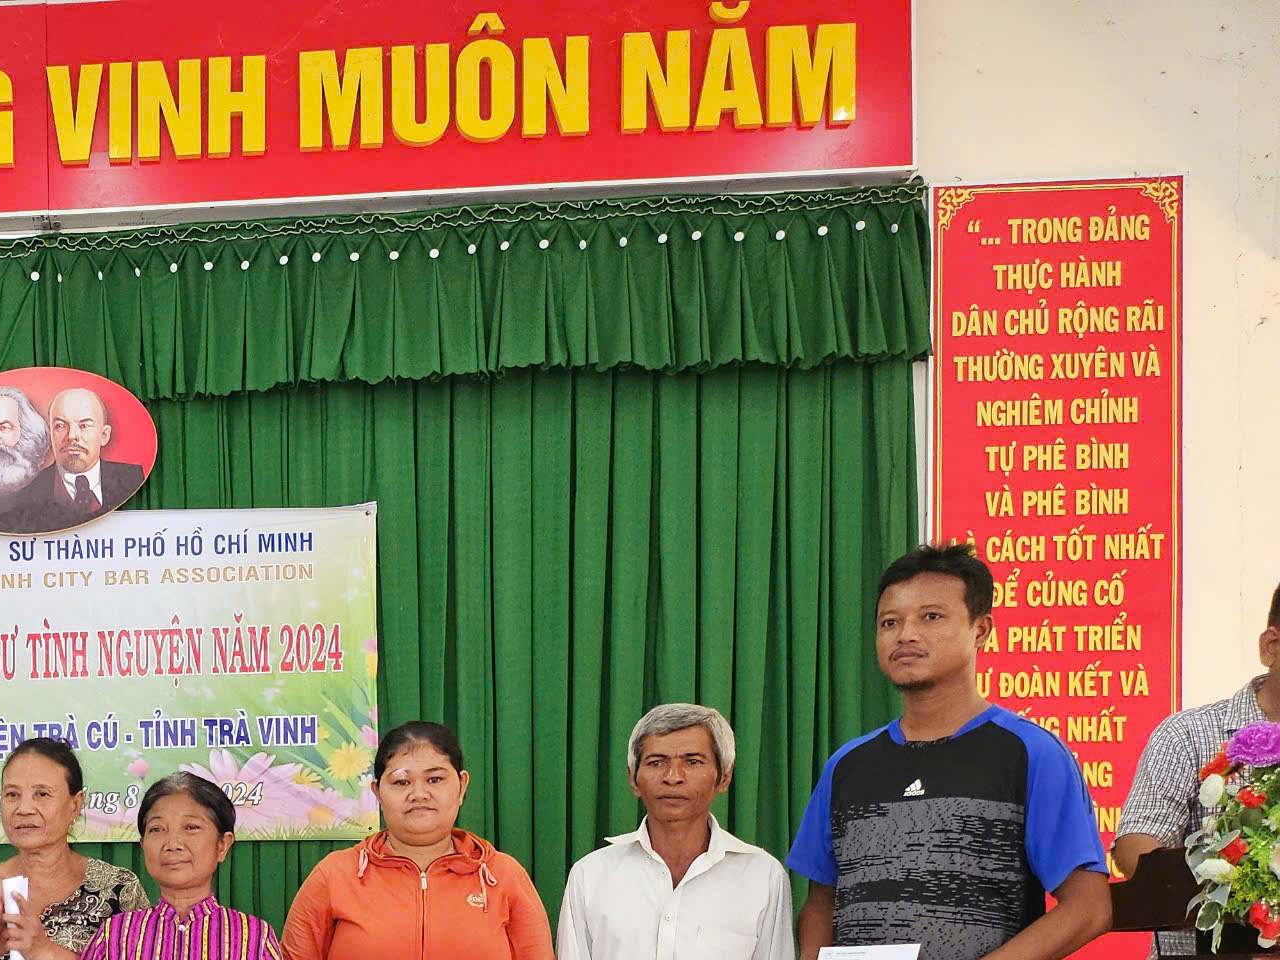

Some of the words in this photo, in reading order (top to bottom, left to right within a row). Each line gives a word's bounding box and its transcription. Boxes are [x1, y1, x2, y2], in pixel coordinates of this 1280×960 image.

[47, 55, 266, 166] VINH
[299, 12, 589, 152] MUÔN
[621, 0, 857, 132] NĂM
[1008, 218, 1082, 244] TRONG
[1088, 206, 1150, 242] ĐẢNG
[993, 258, 1053, 294] THỰC
[1061, 256, 1121, 288] HÀNH
[952, 304, 997, 337] DÂN
[1005, 299, 1049, 335] CHỦ
[1058, 301, 1119, 338] RỘNG
[1127, 299, 1164, 332] RÃI
[954, 349, 1044, 382] THƯỜNG
[1050, 346, 1125, 380] XUYÊN
[1132, 344, 1161, 377] VÀ
[977, 393, 1063, 427] NGHIÊM
[1071, 389, 1138, 424] CHỈNH
[985, 441, 1016, 476] TỰ
[1023, 438, 1066, 471] PHÊ
[1076, 437, 1129, 470] BÌNH
[985, 485, 1014, 517] VÀ
[1023, 483, 1066, 516] PHÊ
[1076, 483, 1129, 515] BÌNH
[9, 538, 37, 561] SƯ
[44, 534, 114, 560] THÀNH
[124, 528, 168, 557] PHỐ
[176, 527, 203, 555] HỒ
[214, 529, 249, 554] CHÍ
[258, 532, 313, 553] MINH
[986, 529, 1046, 562] CÁCH
[1053, 525, 1097, 561] TỐT
[1104, 523, 1165, 560] NHẤT
[43, 571, 93, 588] CITY
[104, 570, 150, 586] BAR
[161, 563, 313, 584] ASSOCIATION
[1026, 571, 1087, 607] CỦNG
[1094, 569, 1127, 606] CỐ
[26, 617, 89, 679] TÌNH
[97, 613, 203, 687] NGUYỆN
[211, 612, 271, 673] NĂM
[280, 623, 343, 673] 2024
[1008, 619, 1066, 652] PHÁT
[1073, 612, 1142, 651] TRIỂN
[999, 665, 1060, 698] ĐOÀN
[1068, 661, 1112, 697] KẾT
[1120, 664, 1149, 697] VÀ
[85, 715, 118, 750] CÚ
[139, 709, 196, 747] TỈNH
[204, 709, 251, 746] TRÀ
[257, 716, 317, 745] VINH
[1067, 706, 1127, 742] NHẤT
[124, 784, 139, 808] 8
